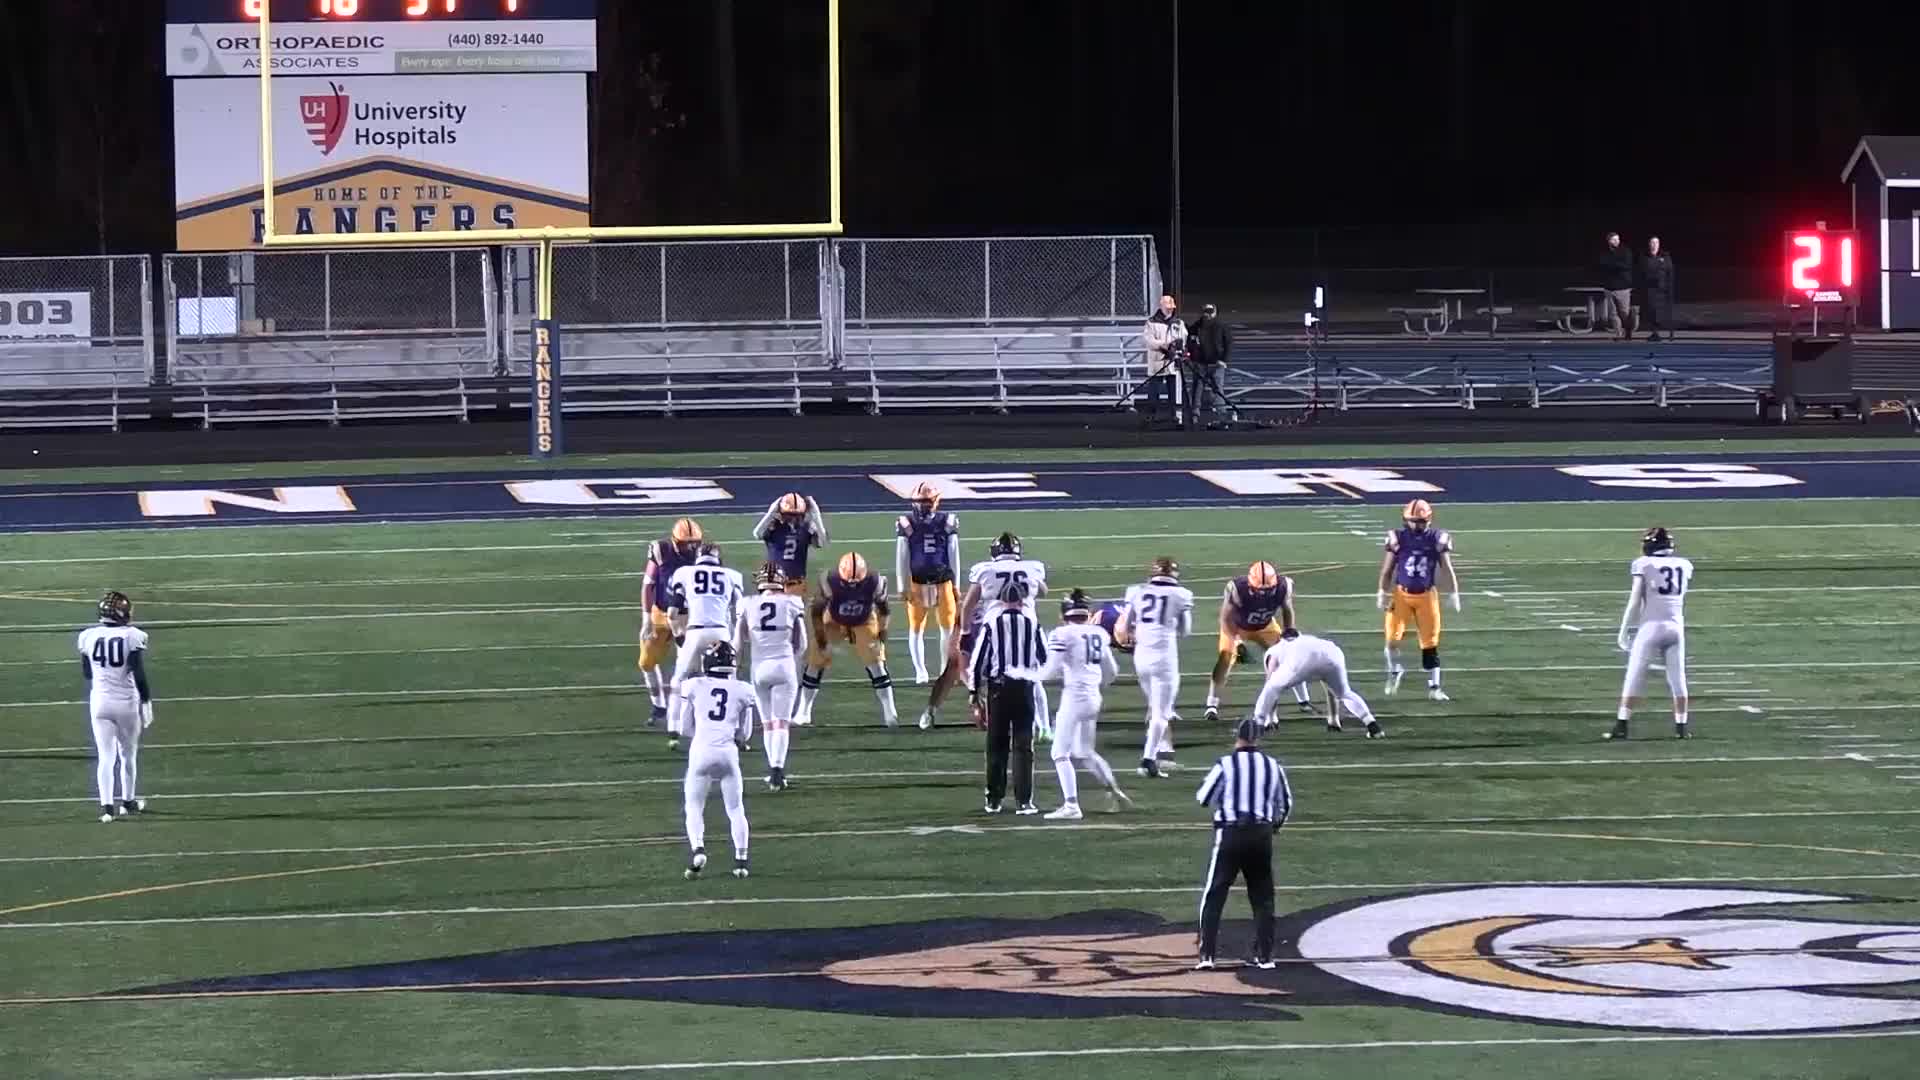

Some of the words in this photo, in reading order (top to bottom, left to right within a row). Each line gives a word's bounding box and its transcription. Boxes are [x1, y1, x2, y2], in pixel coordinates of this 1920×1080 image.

[216, 36, 385, 50] ORTHOPAEDIC
[448, 33, 481, 47] (440)
[484, 33, 544, 45] 892-1440
[242, 57, 359, 69] ASSOCIATES
[354, 101, 467, 124] University
[355, 125, 456, 149] Hospitals
[314, 187, 367, 201] HOME
[380, 187, 402, 200] OF
[414, 185, 453, 199] THE
[1792, 236, 1852, 289] 21
[535, 328, 552, 452] RANGERS
[783, 539, 797, 560] 2
[1404, 556, 1428, 577] 44
[694, 570, 725, 595] 95
[1658, 566, 1684, 595] 31
[760, 602, 777, 631] 2
[1141, 594, 1169, 625] 21
[92, 636, 125, 668] 40
[1081, 633, 1102, 665] 18
[708, 688, 729, 721] 3
